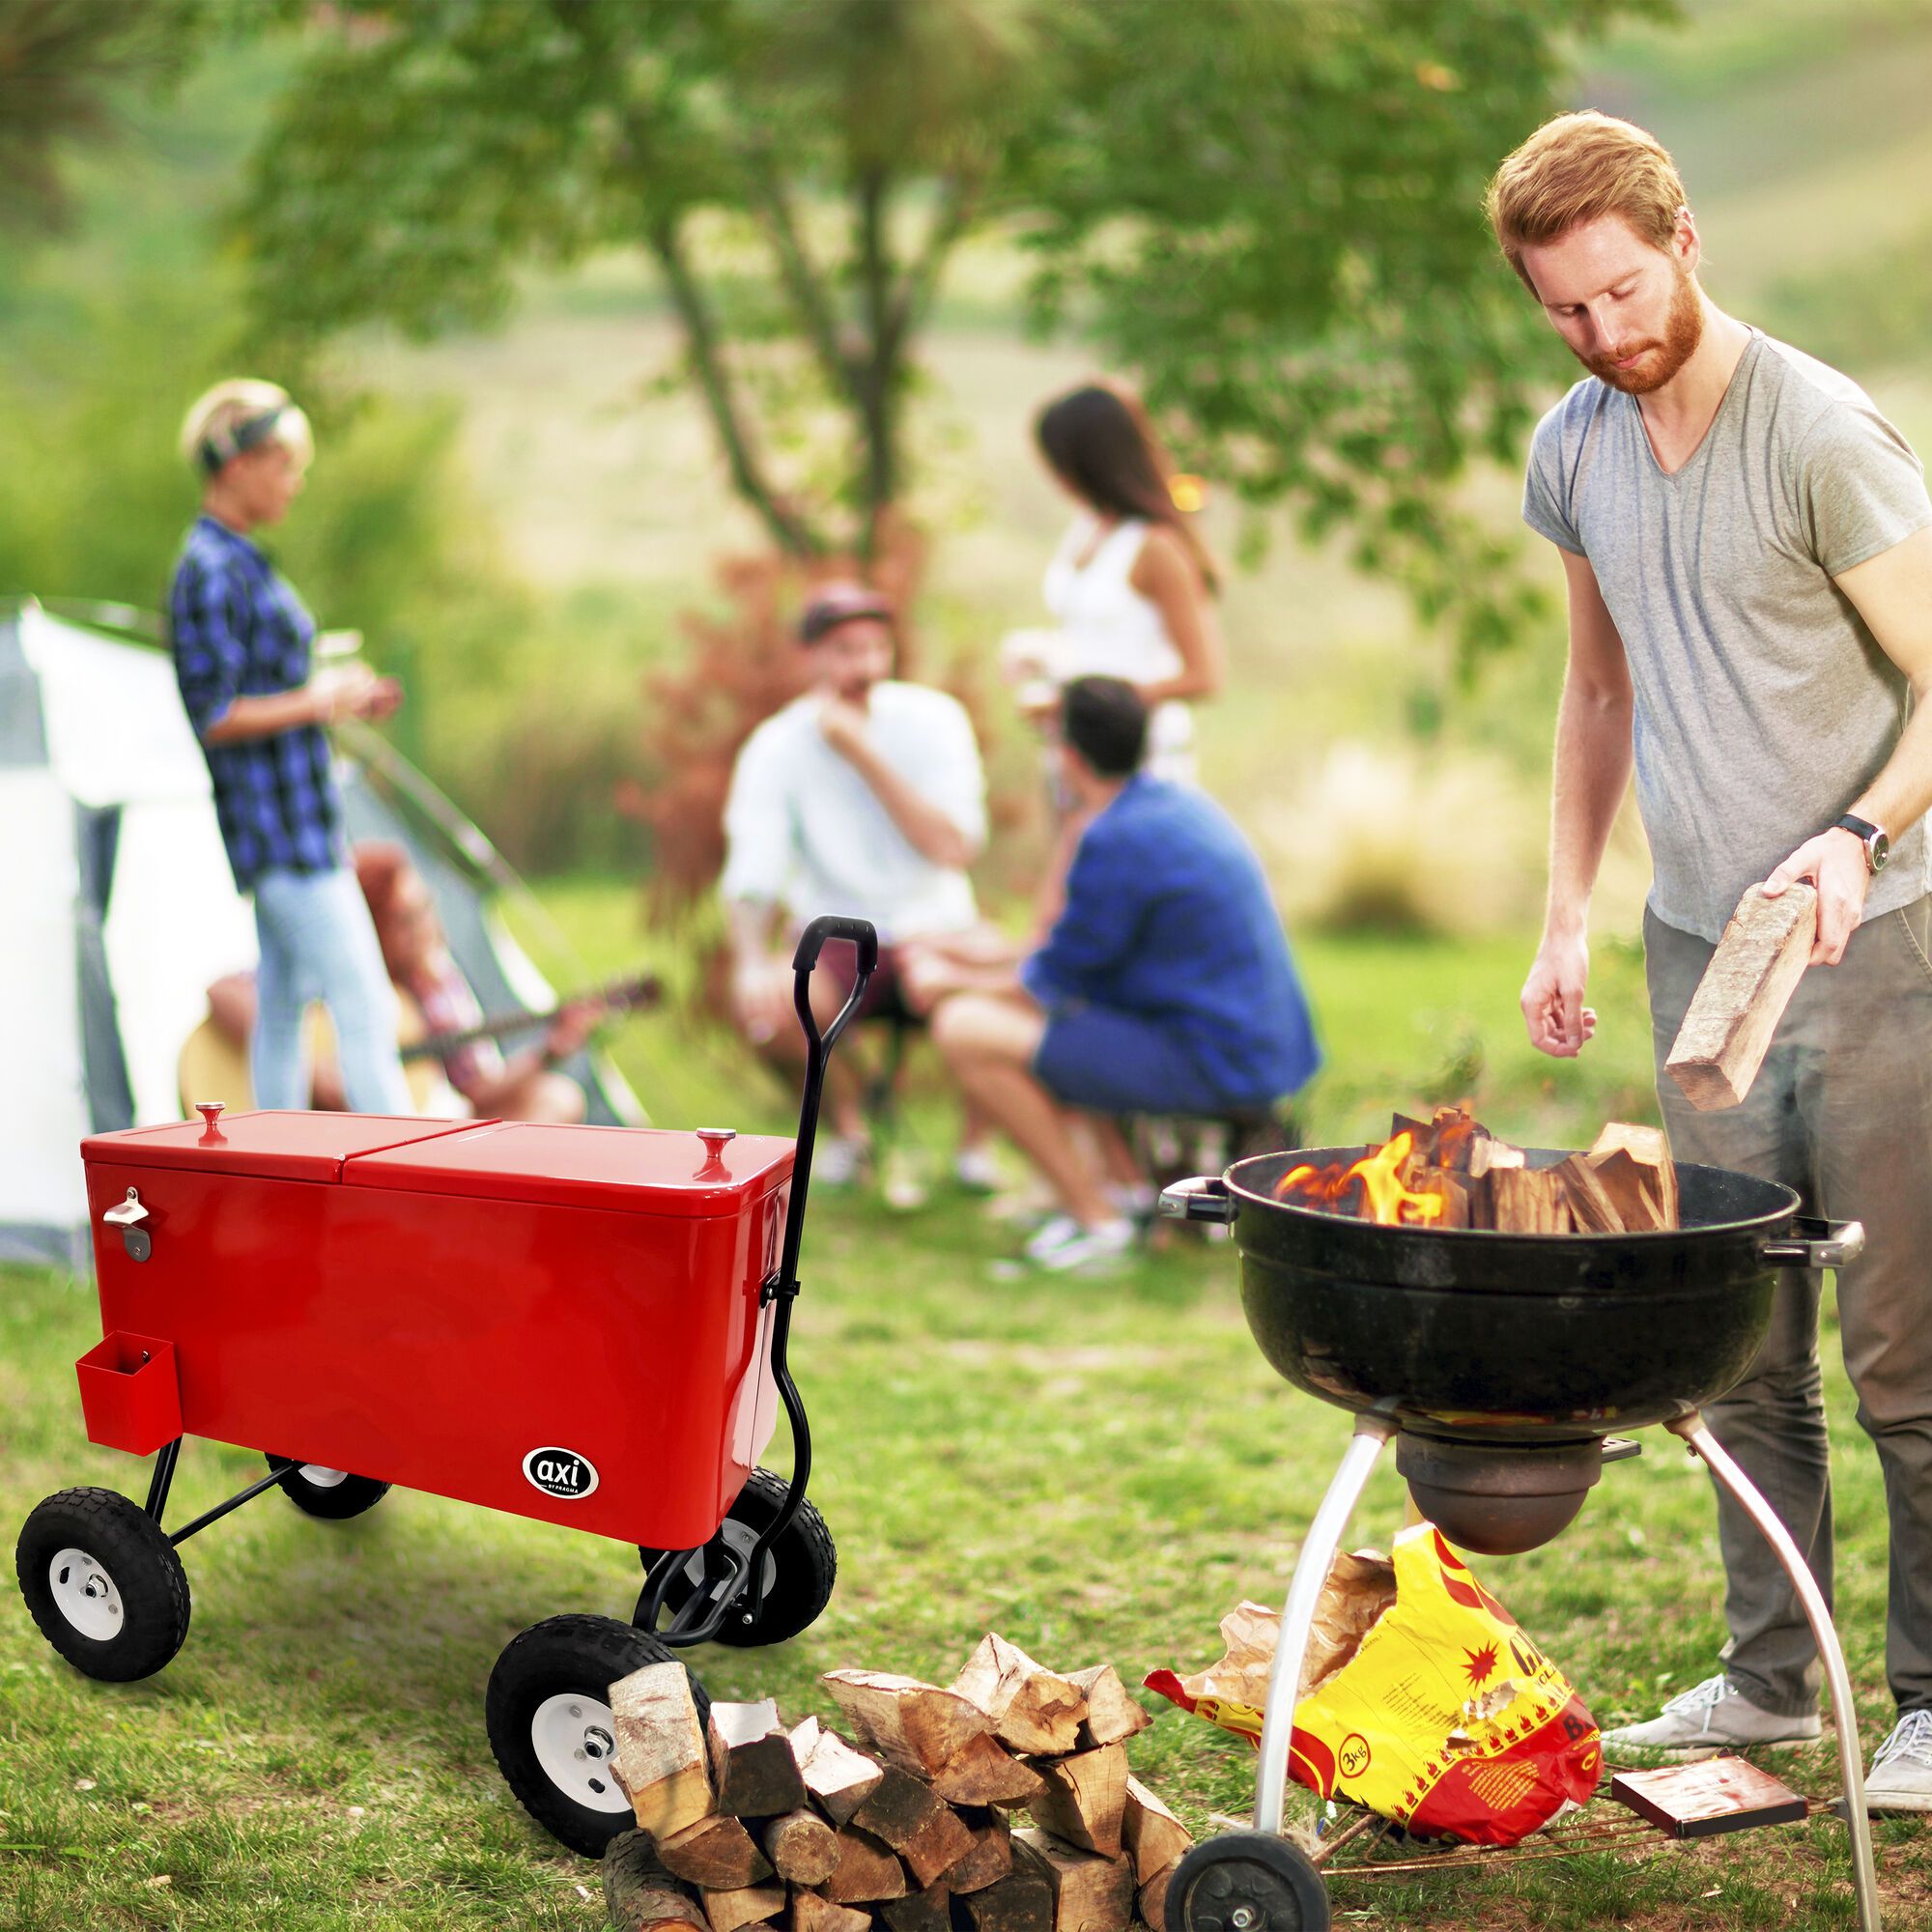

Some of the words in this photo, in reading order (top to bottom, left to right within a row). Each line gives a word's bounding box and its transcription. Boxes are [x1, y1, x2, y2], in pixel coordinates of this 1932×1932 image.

[537, 1460, 580, 1487] axi
[555, 1485, 579, 1493] PRAGMA
[1343, 1746, 1367, 1772] 3kg
